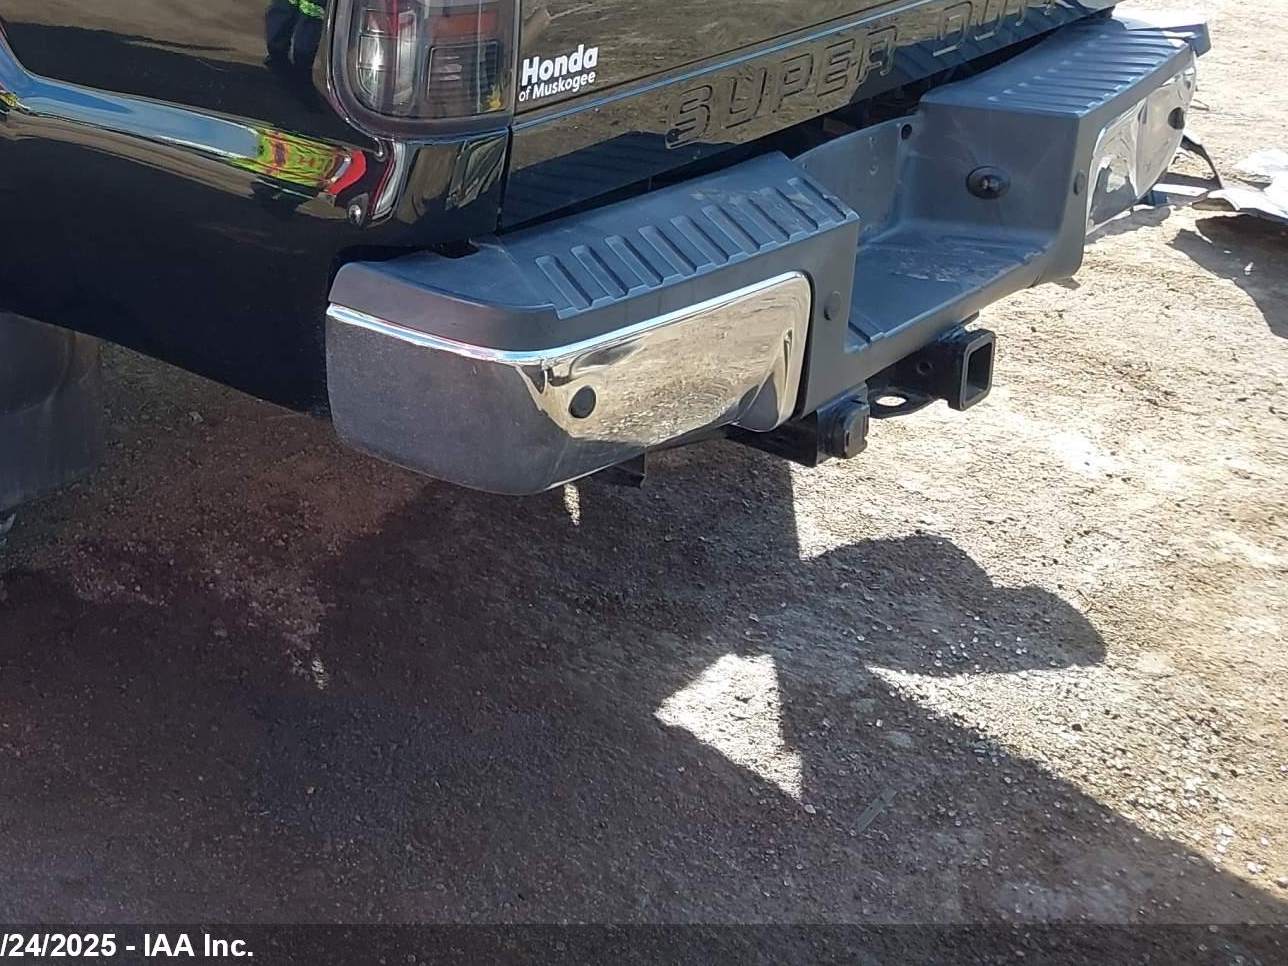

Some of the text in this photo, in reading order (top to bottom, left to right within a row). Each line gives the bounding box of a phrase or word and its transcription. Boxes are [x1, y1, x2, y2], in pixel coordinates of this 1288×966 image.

[518, 71, 596, 102] of Muskogee
[521, 44, 599, 87] Honda
[665, 24, 899, 149] SUPER
